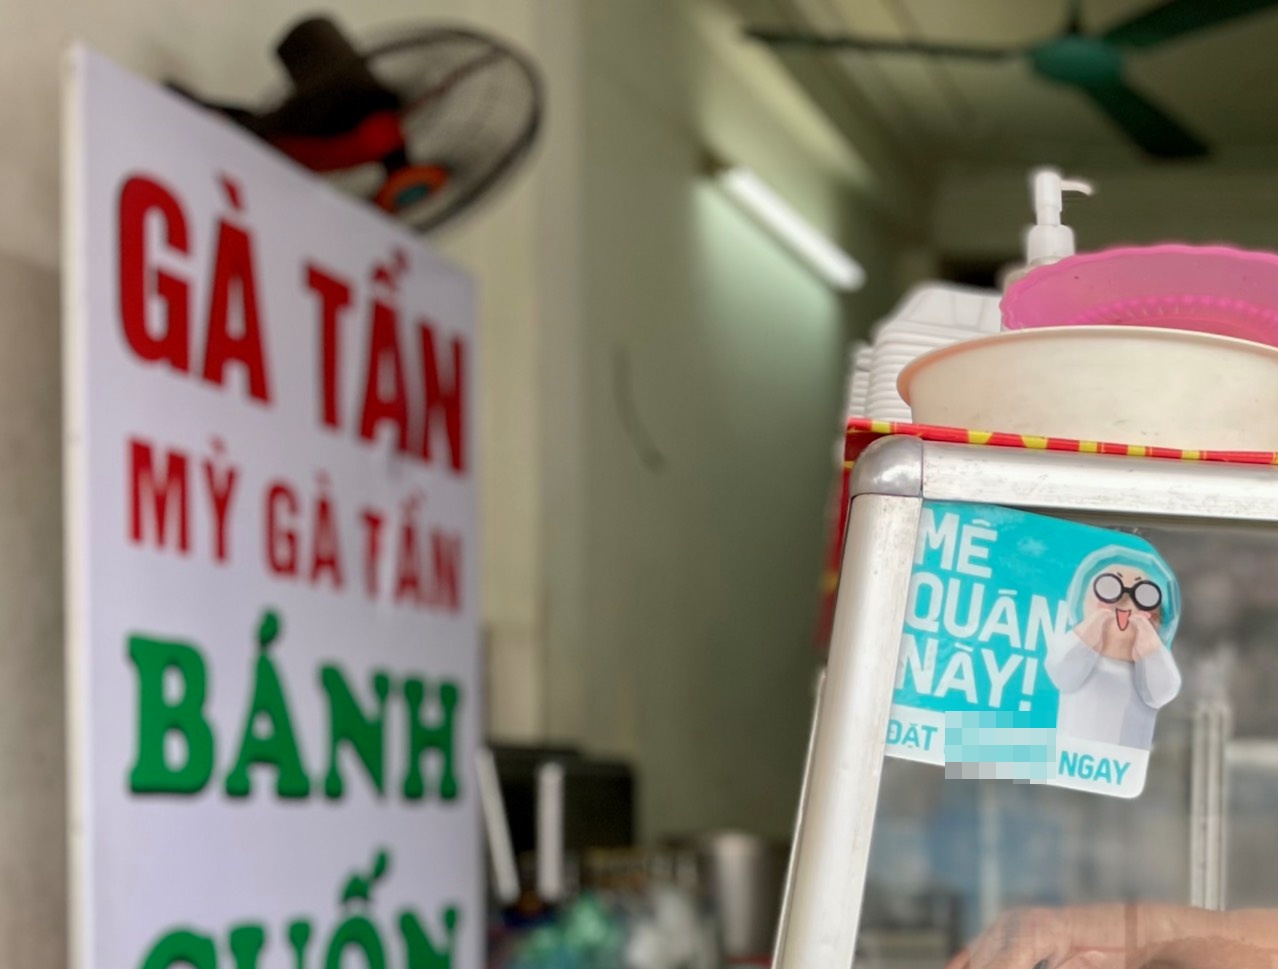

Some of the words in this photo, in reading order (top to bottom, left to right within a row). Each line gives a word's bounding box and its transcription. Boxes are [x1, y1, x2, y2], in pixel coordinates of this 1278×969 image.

[117, 171, 273, 406] GÀ
[129, 434, 237, 564] MỲ
[265, 469, 345, 590] GÀ
[913, 507, 998, 578] MÊ
[127, 608, 460, 801] BÁNH
[895, 634, 1039, 712] NÀY!
[1058, 750, 1131, 785] NGAY
